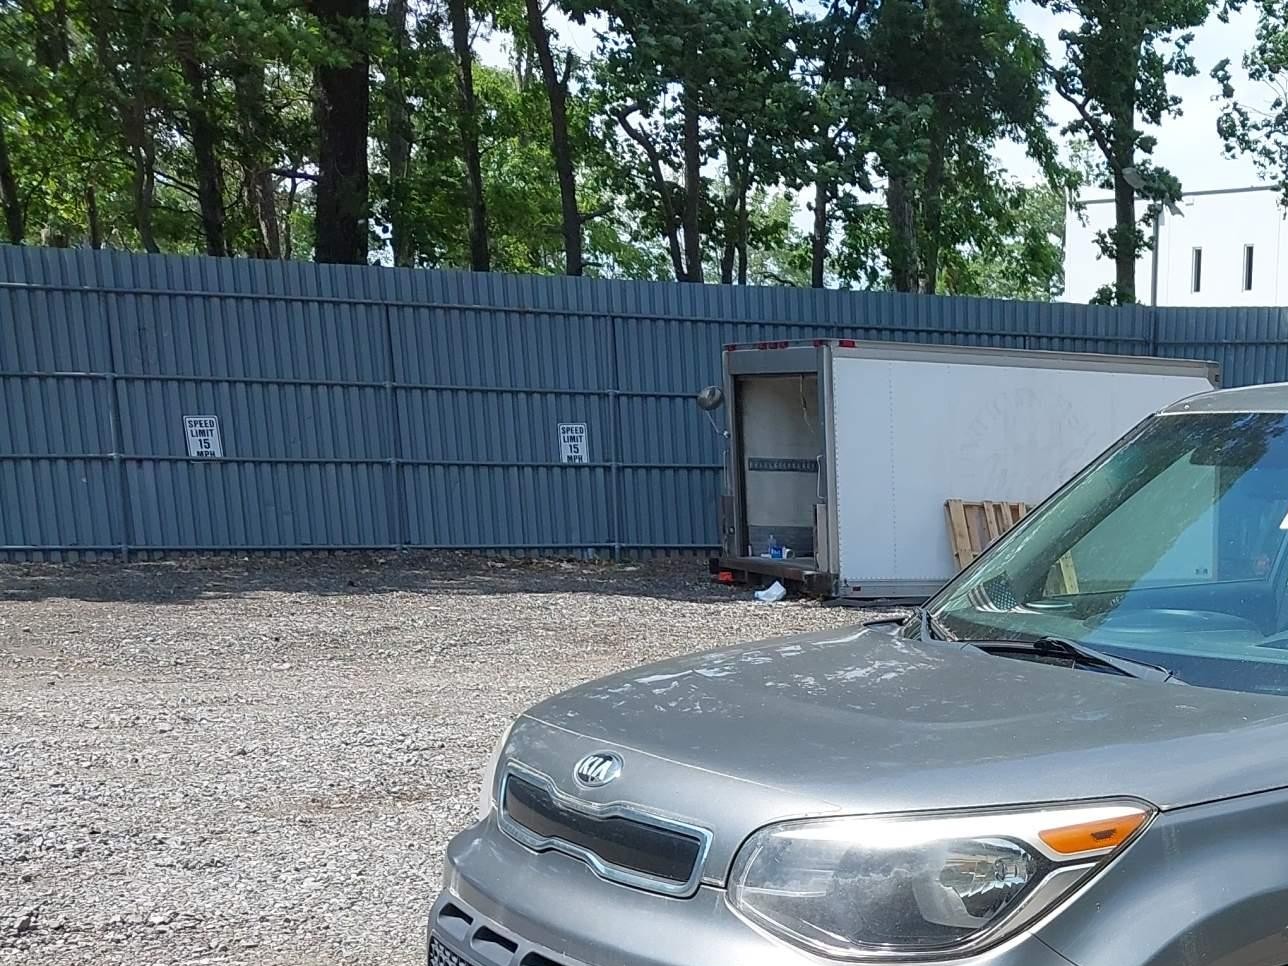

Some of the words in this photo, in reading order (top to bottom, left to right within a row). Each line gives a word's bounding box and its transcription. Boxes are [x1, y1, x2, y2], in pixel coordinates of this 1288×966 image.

[188, 420, 215, 428] SPEED
[190, 429, 214, 437] LIMIT
[562, 435, 583, 443] LIMIT
[199, 439, 211, 449] 15
[569, 444, 579, 454] 15
[567, 455, 583, 463] MPH
[579, 756, 612, 781] KIA
